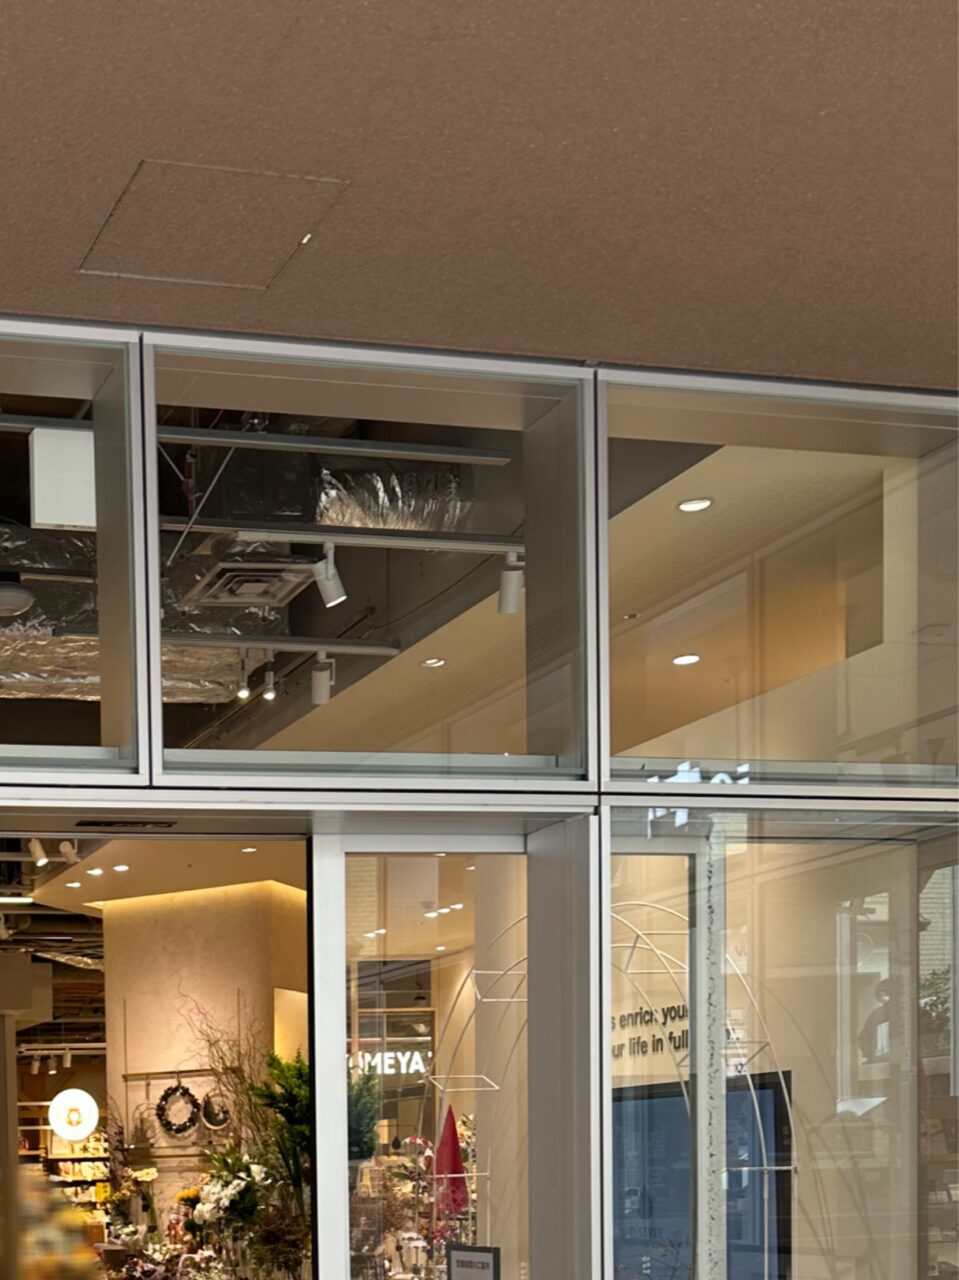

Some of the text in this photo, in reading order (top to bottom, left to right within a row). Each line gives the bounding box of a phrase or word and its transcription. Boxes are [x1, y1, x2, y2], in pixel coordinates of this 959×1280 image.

[661, 1004, 688, 1025] you
[629, 1036, 648, 1055] life
[652, 1034, 664, 1052] in
